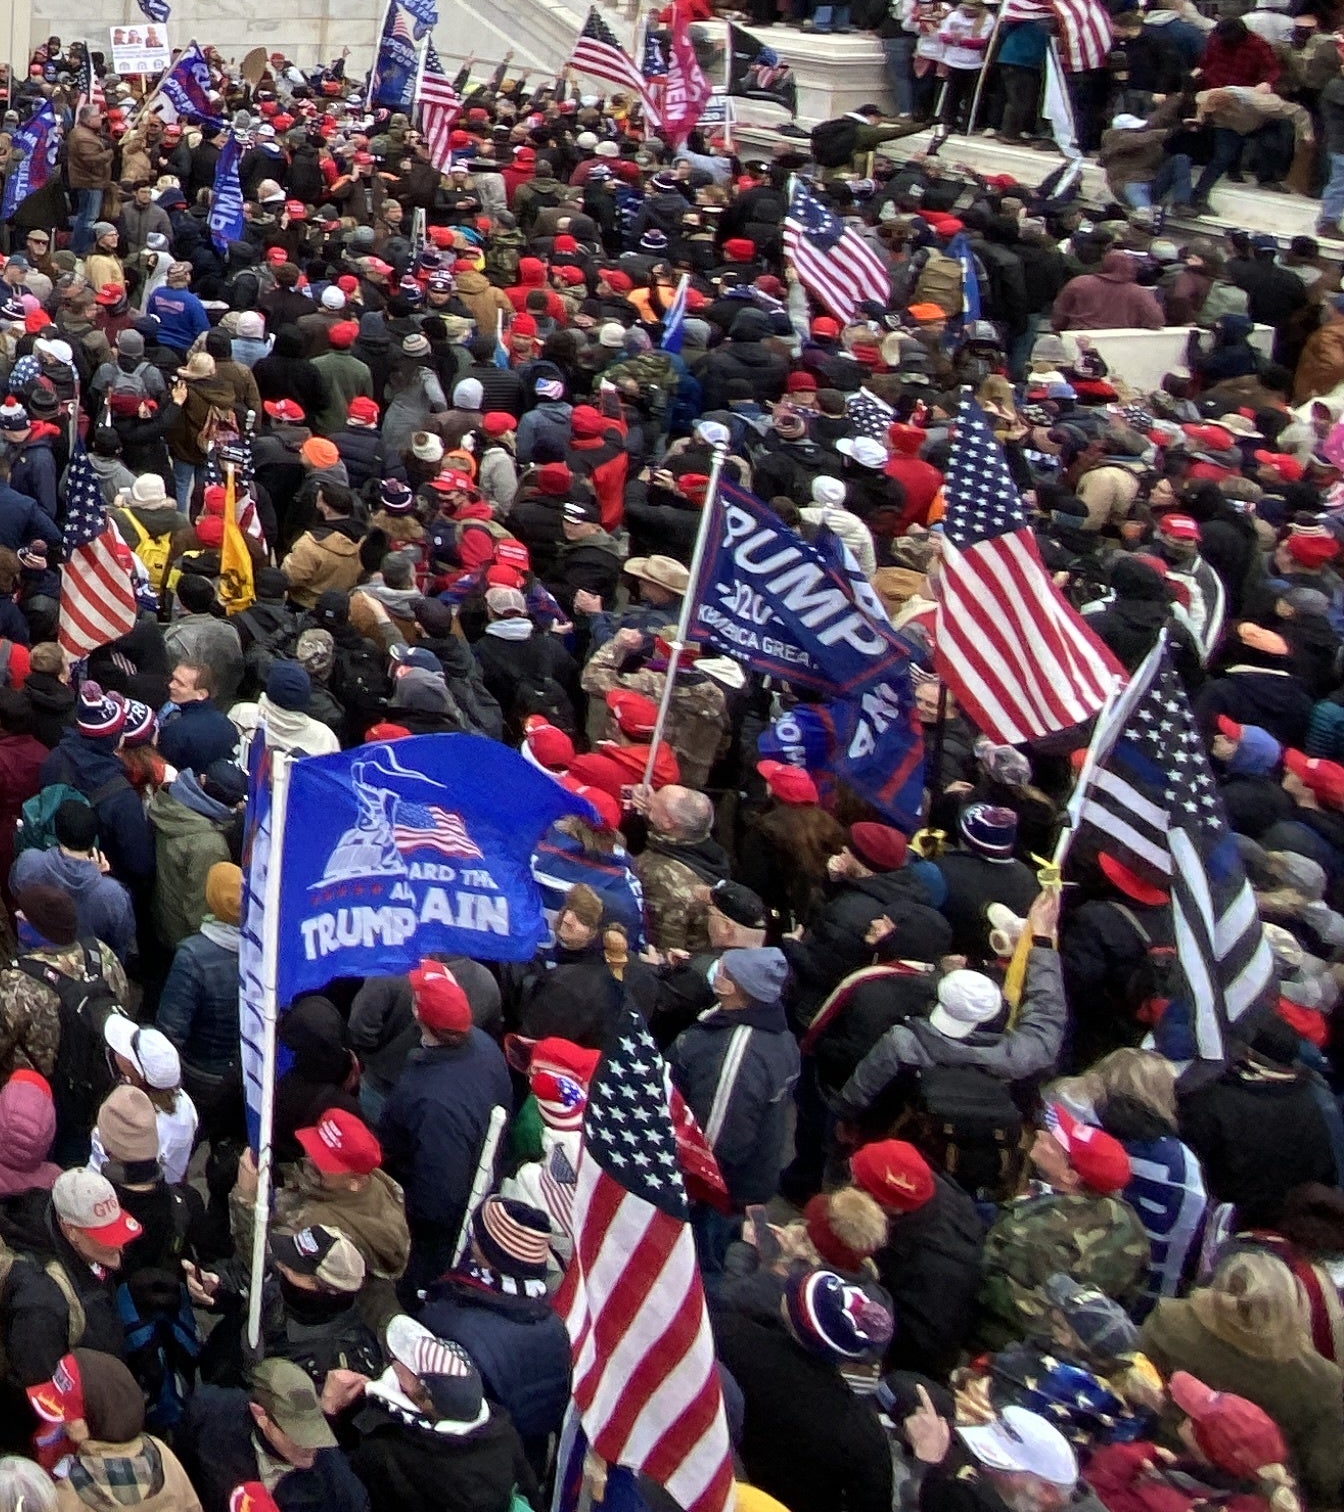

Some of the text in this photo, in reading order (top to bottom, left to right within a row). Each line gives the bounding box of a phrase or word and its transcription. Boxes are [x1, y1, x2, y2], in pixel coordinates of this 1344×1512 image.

[721, 498, 890, 657] RUMP
[300, 888, 510, 961] TRUMP AIN
